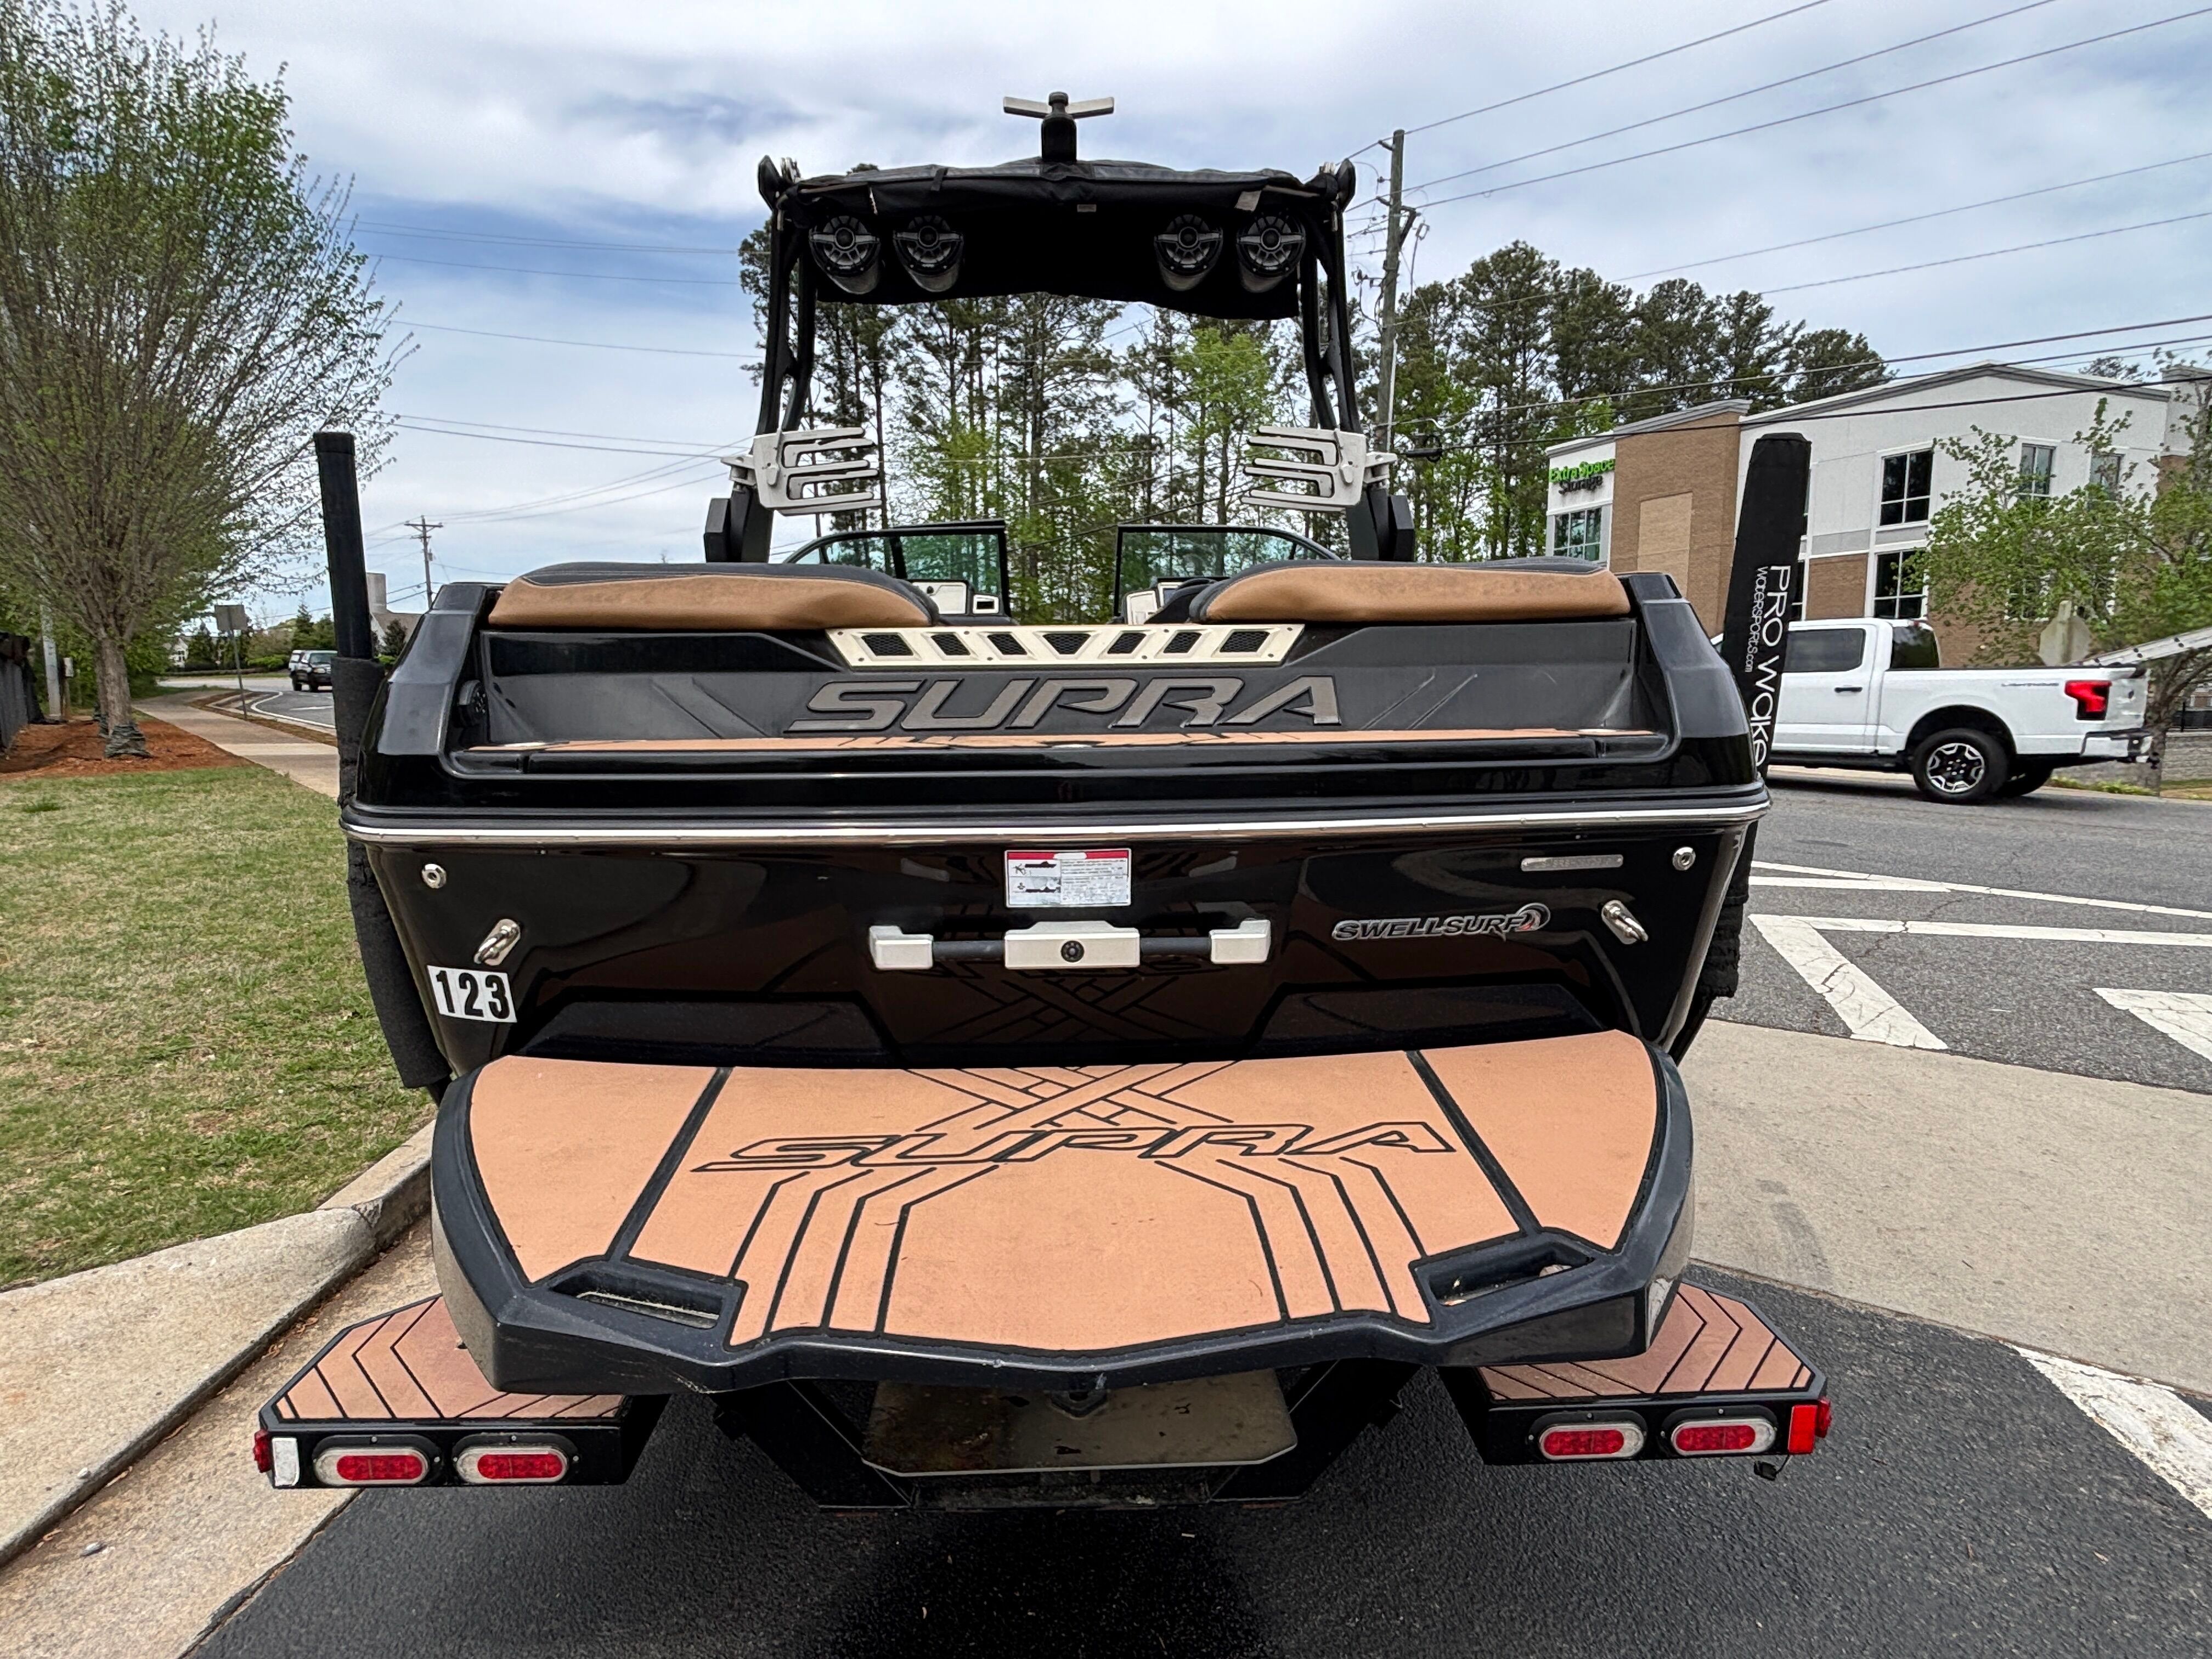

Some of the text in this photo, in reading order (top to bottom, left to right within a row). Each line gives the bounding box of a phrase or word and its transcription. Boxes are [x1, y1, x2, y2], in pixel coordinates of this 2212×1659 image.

[1549, 459, 1616, 482] Extra Space
[1559, 475, 1603, 494] Storage
[1762, 566, 1791, 646] PRO
[783, 676, 1342, 732] SUPRA
[1332, 915, 1527, 941] SWELLSURF
[436, 970, 510, 1019] 123
[691, 1121, 1457, 1172] SUPRA
